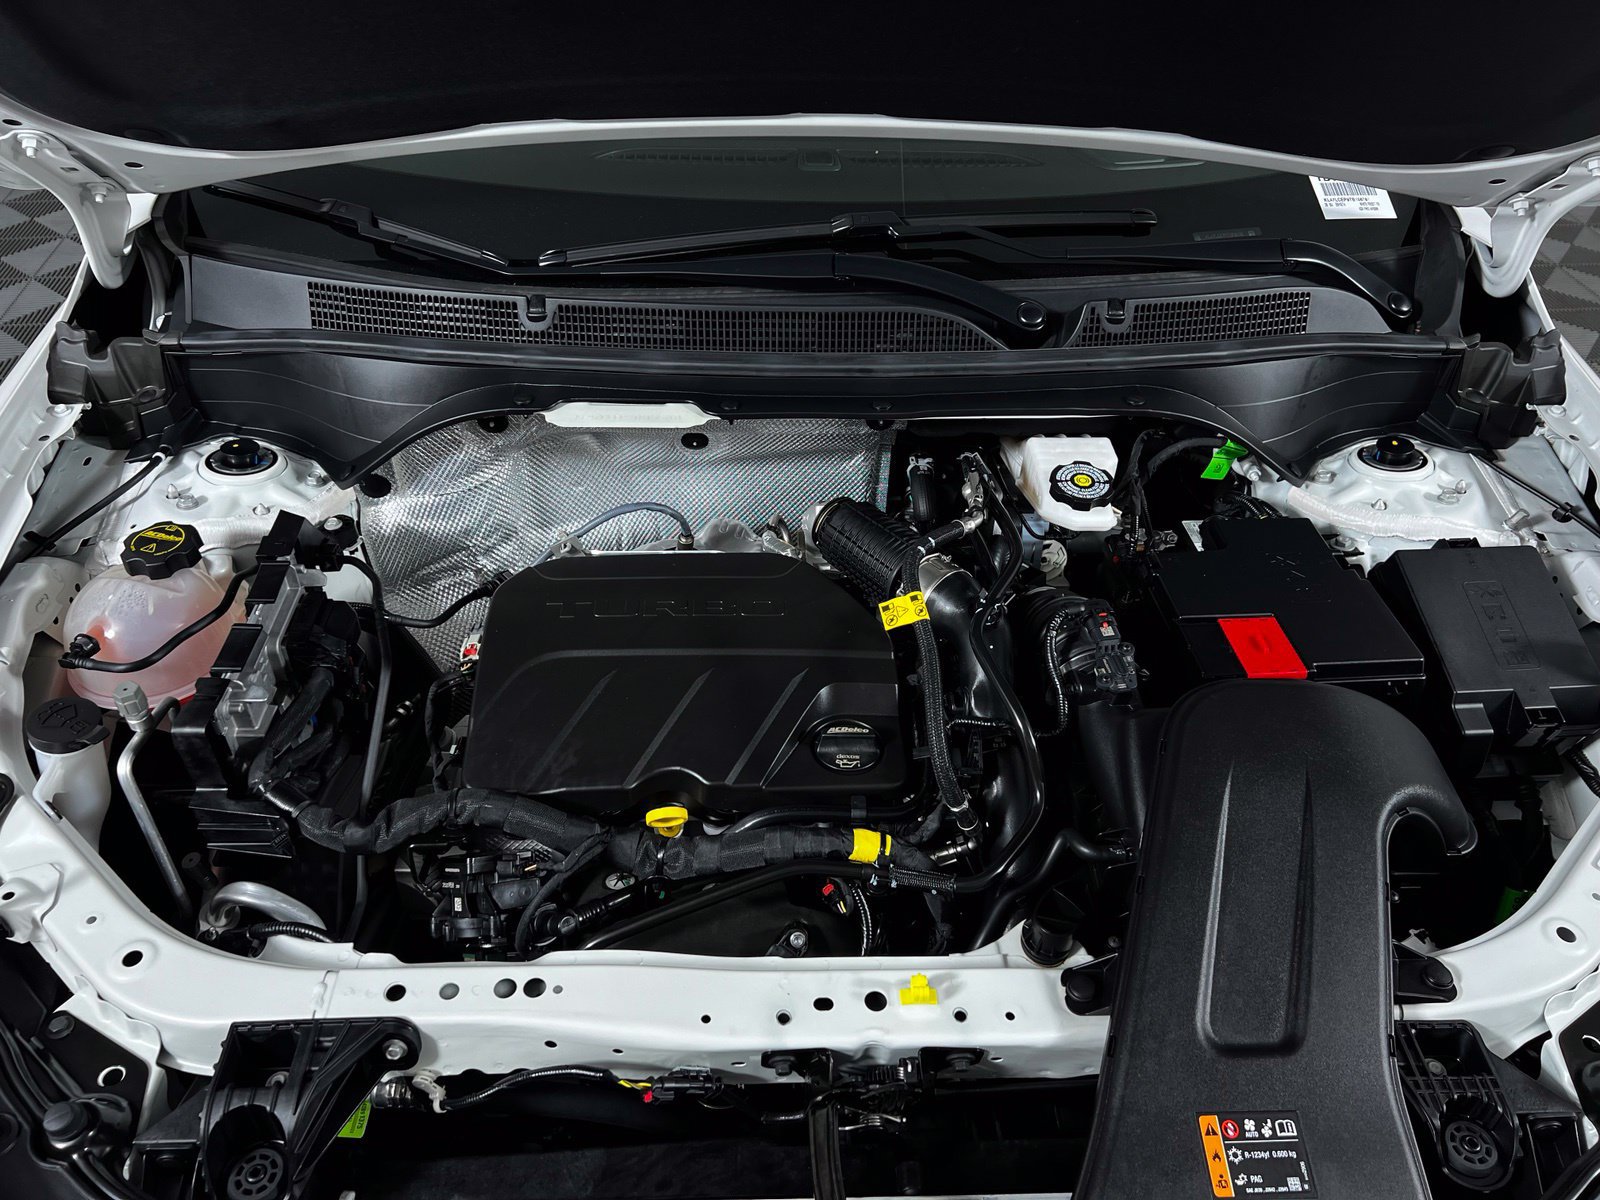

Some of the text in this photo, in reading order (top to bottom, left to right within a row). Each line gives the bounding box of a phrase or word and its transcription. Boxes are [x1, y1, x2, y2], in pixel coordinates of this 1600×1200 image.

[545, 600, 787, 619] TURBO
[826, 726, 870, 734] ACDelco
[1250, 1175, 1263, 1183] PAG
